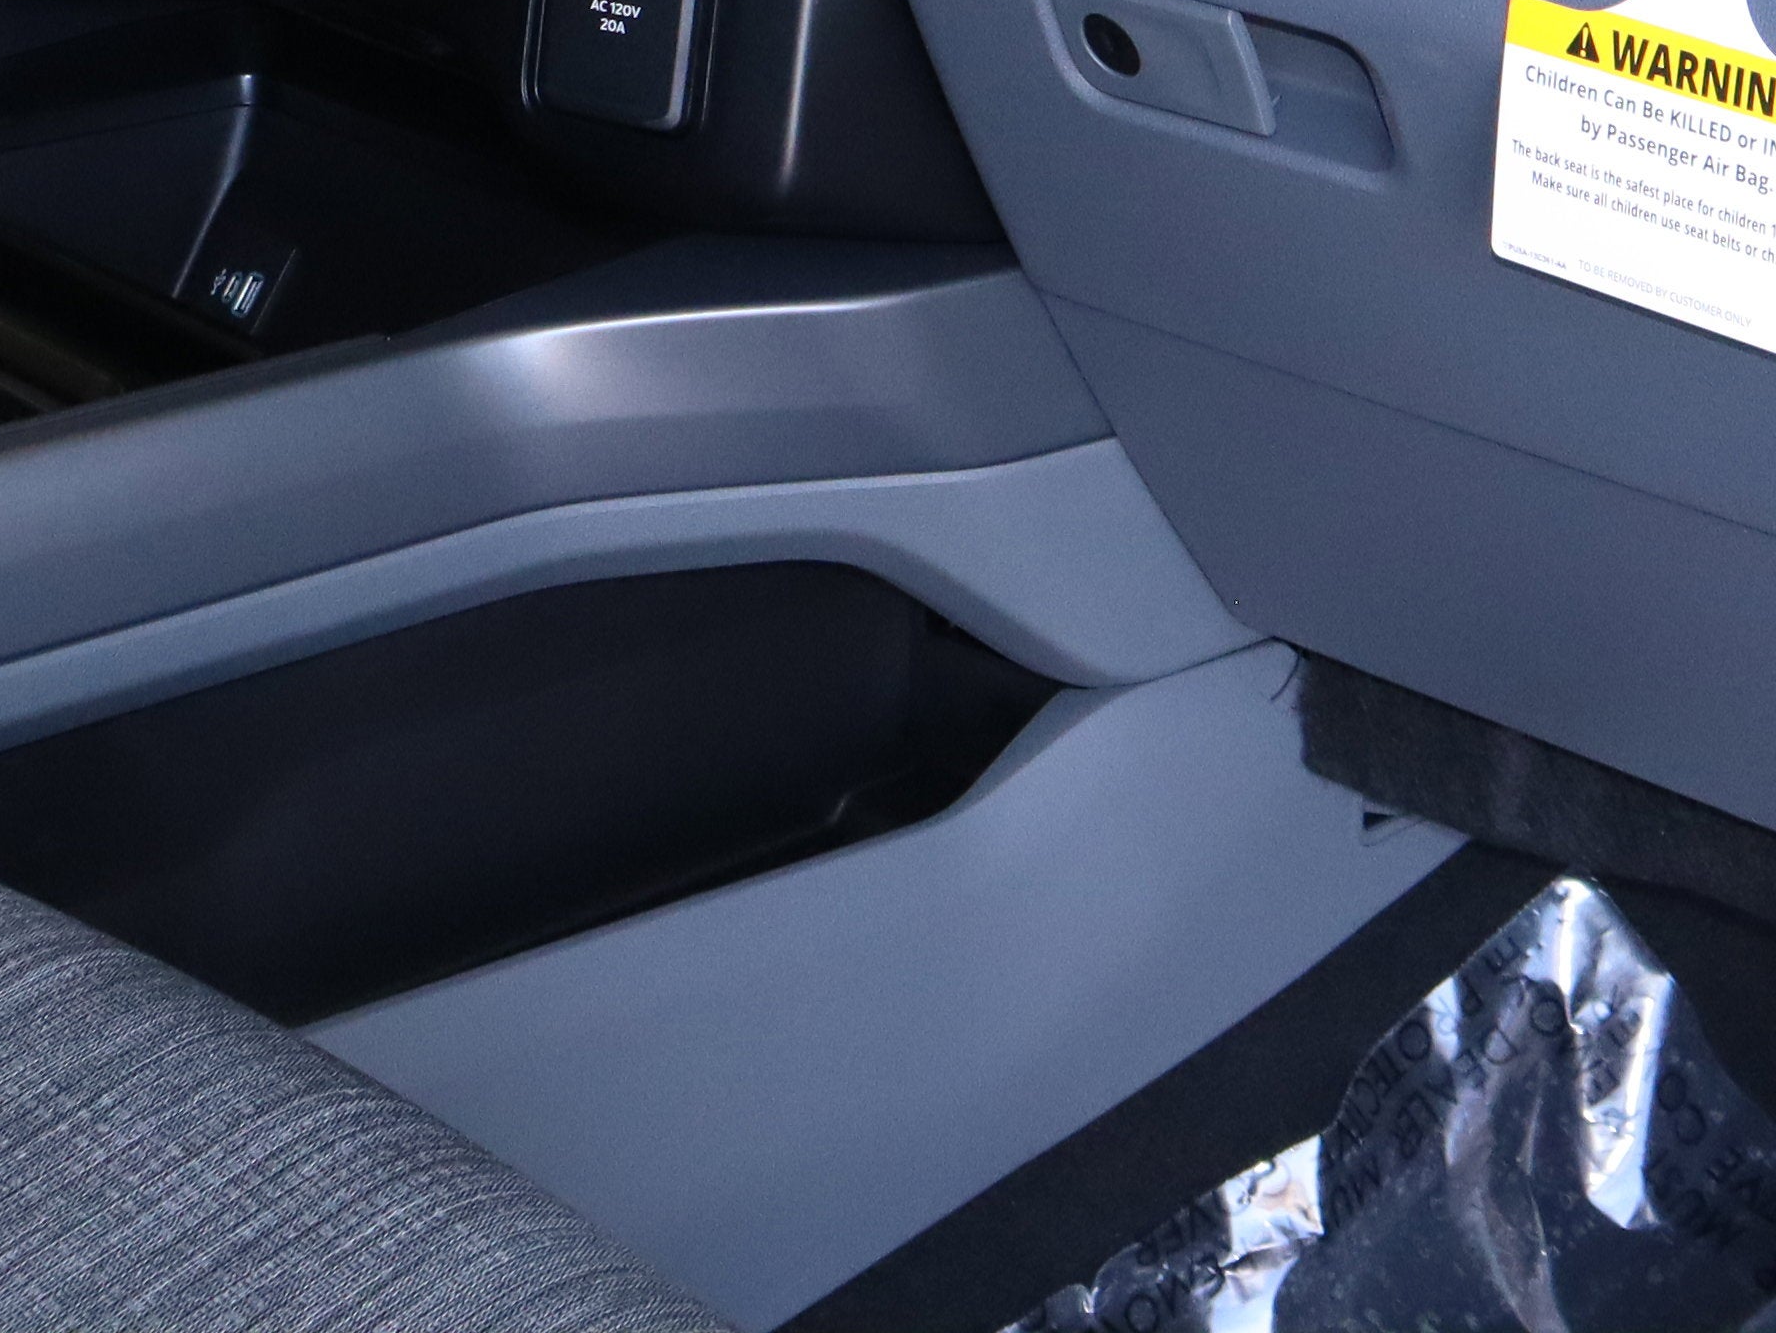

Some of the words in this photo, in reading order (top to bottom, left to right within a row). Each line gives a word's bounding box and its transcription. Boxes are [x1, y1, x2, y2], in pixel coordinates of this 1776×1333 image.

[599, 17, 626, 35] 20A
[610, 1, 641, 20] 120V
[1525, 65, 1598, 102] Children
[1604, 90, 1636, 115] Can
[1643, 101, 1664, 123] Be
[1670, 109, 1731, 143] KILLED
[1738, 135, 1758, 150] or
[1512, 140, 1531, 158] The
[1535, 146, 1560, 167] back
[1564, 157, 1587, 176] seat
[1591, 164, 1600, 179] is
[1603, 167, 1622, 187] the
[1626, 175, 1659, 199] safest
[1664, 187, 1694, 212] place
[1698, 198, 1713, 218] for
[1719, 204, 1766, 234] children
[1581, 115, 1600, 139] by
[1607, 125, 1697, 168] Passenger
[1703, 156, 1729, 177] Air
[1736, 164, 1773, 195] Bag.
[1532, 171, 1561, 192] Make
[1566, 184, 1589, 201] sure
[1594, 189, 1607, 208] all
[1611, 197, 1657, 223] children
[1662, 215, 1680, 232] use
[1685, 222, 1708, 241] seat
[1713, 231, 1740, 253] belts
[1745, 245, 1757, 258] or
[1579, 259, 1591, 273] TO
[1594, 264, 1605, 278] BE
[1607, 268, 1652, 295] REMOVED
[1656, 285, 1668, 299] BY
[1670, 290, 1723, 319] CUSTOMER
[1725, 309, 1752, 328] ONLY
